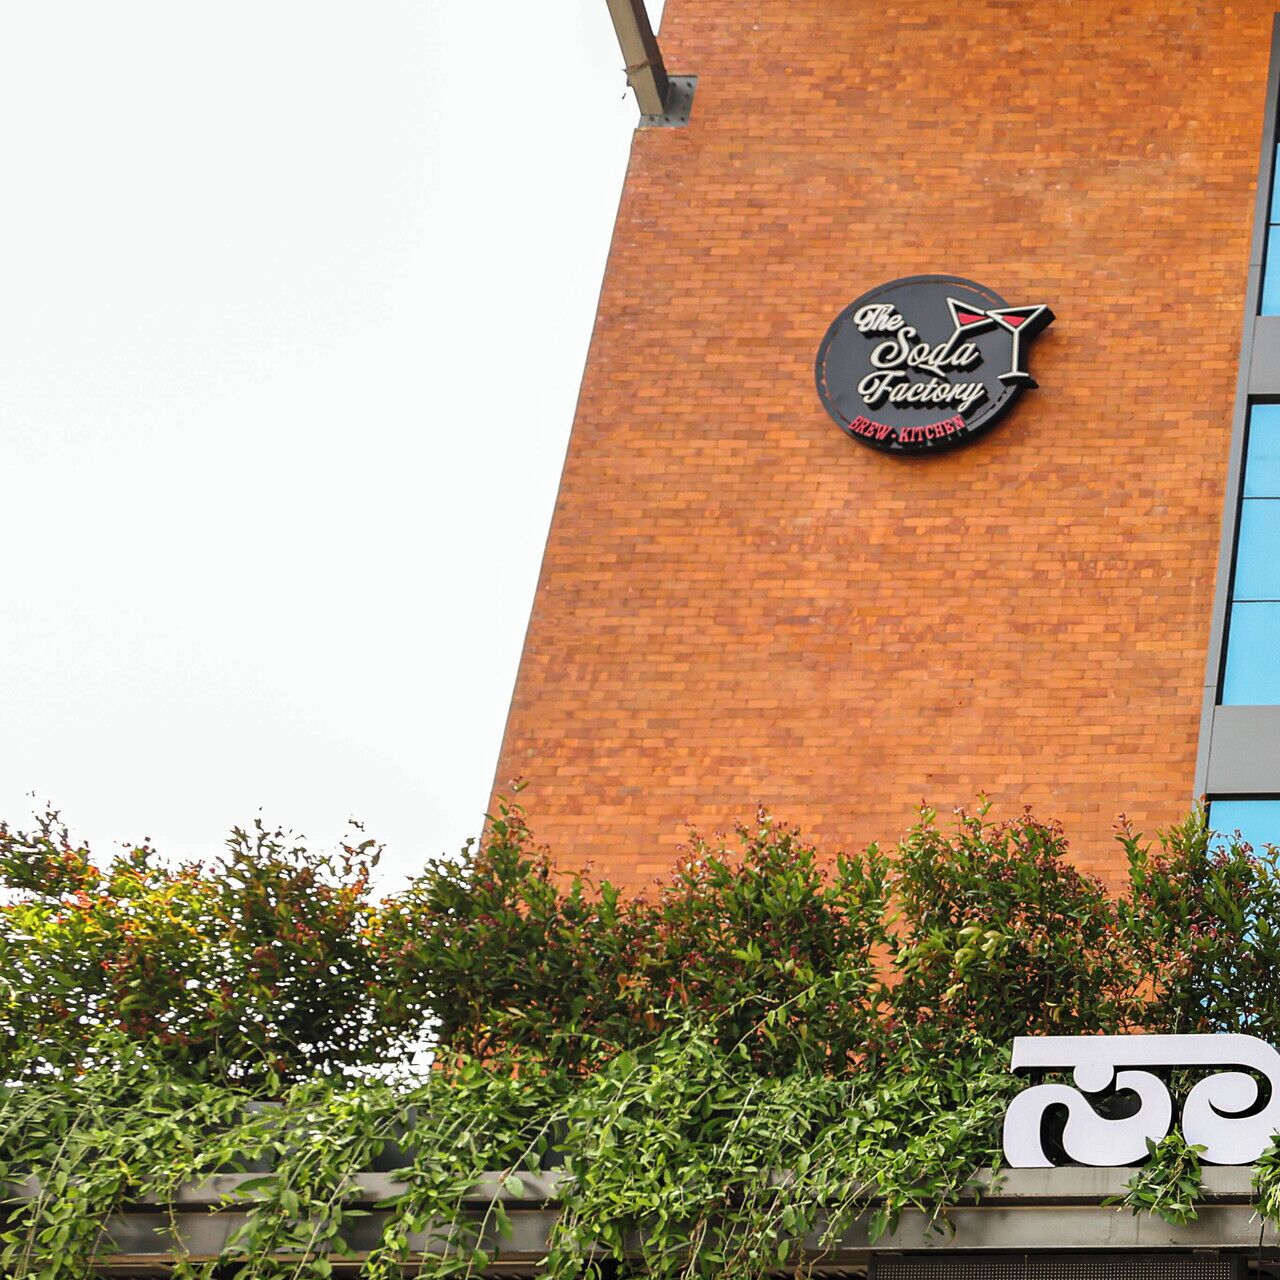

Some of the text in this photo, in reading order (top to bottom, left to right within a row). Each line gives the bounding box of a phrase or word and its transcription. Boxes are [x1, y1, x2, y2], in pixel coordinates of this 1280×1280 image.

[853, 303, 905, 332] The
[870, 326, 980, 368] Soda
[858, 370, 985, 412] Factory
[848, 414, 966, 443] BREW KITCHEN
